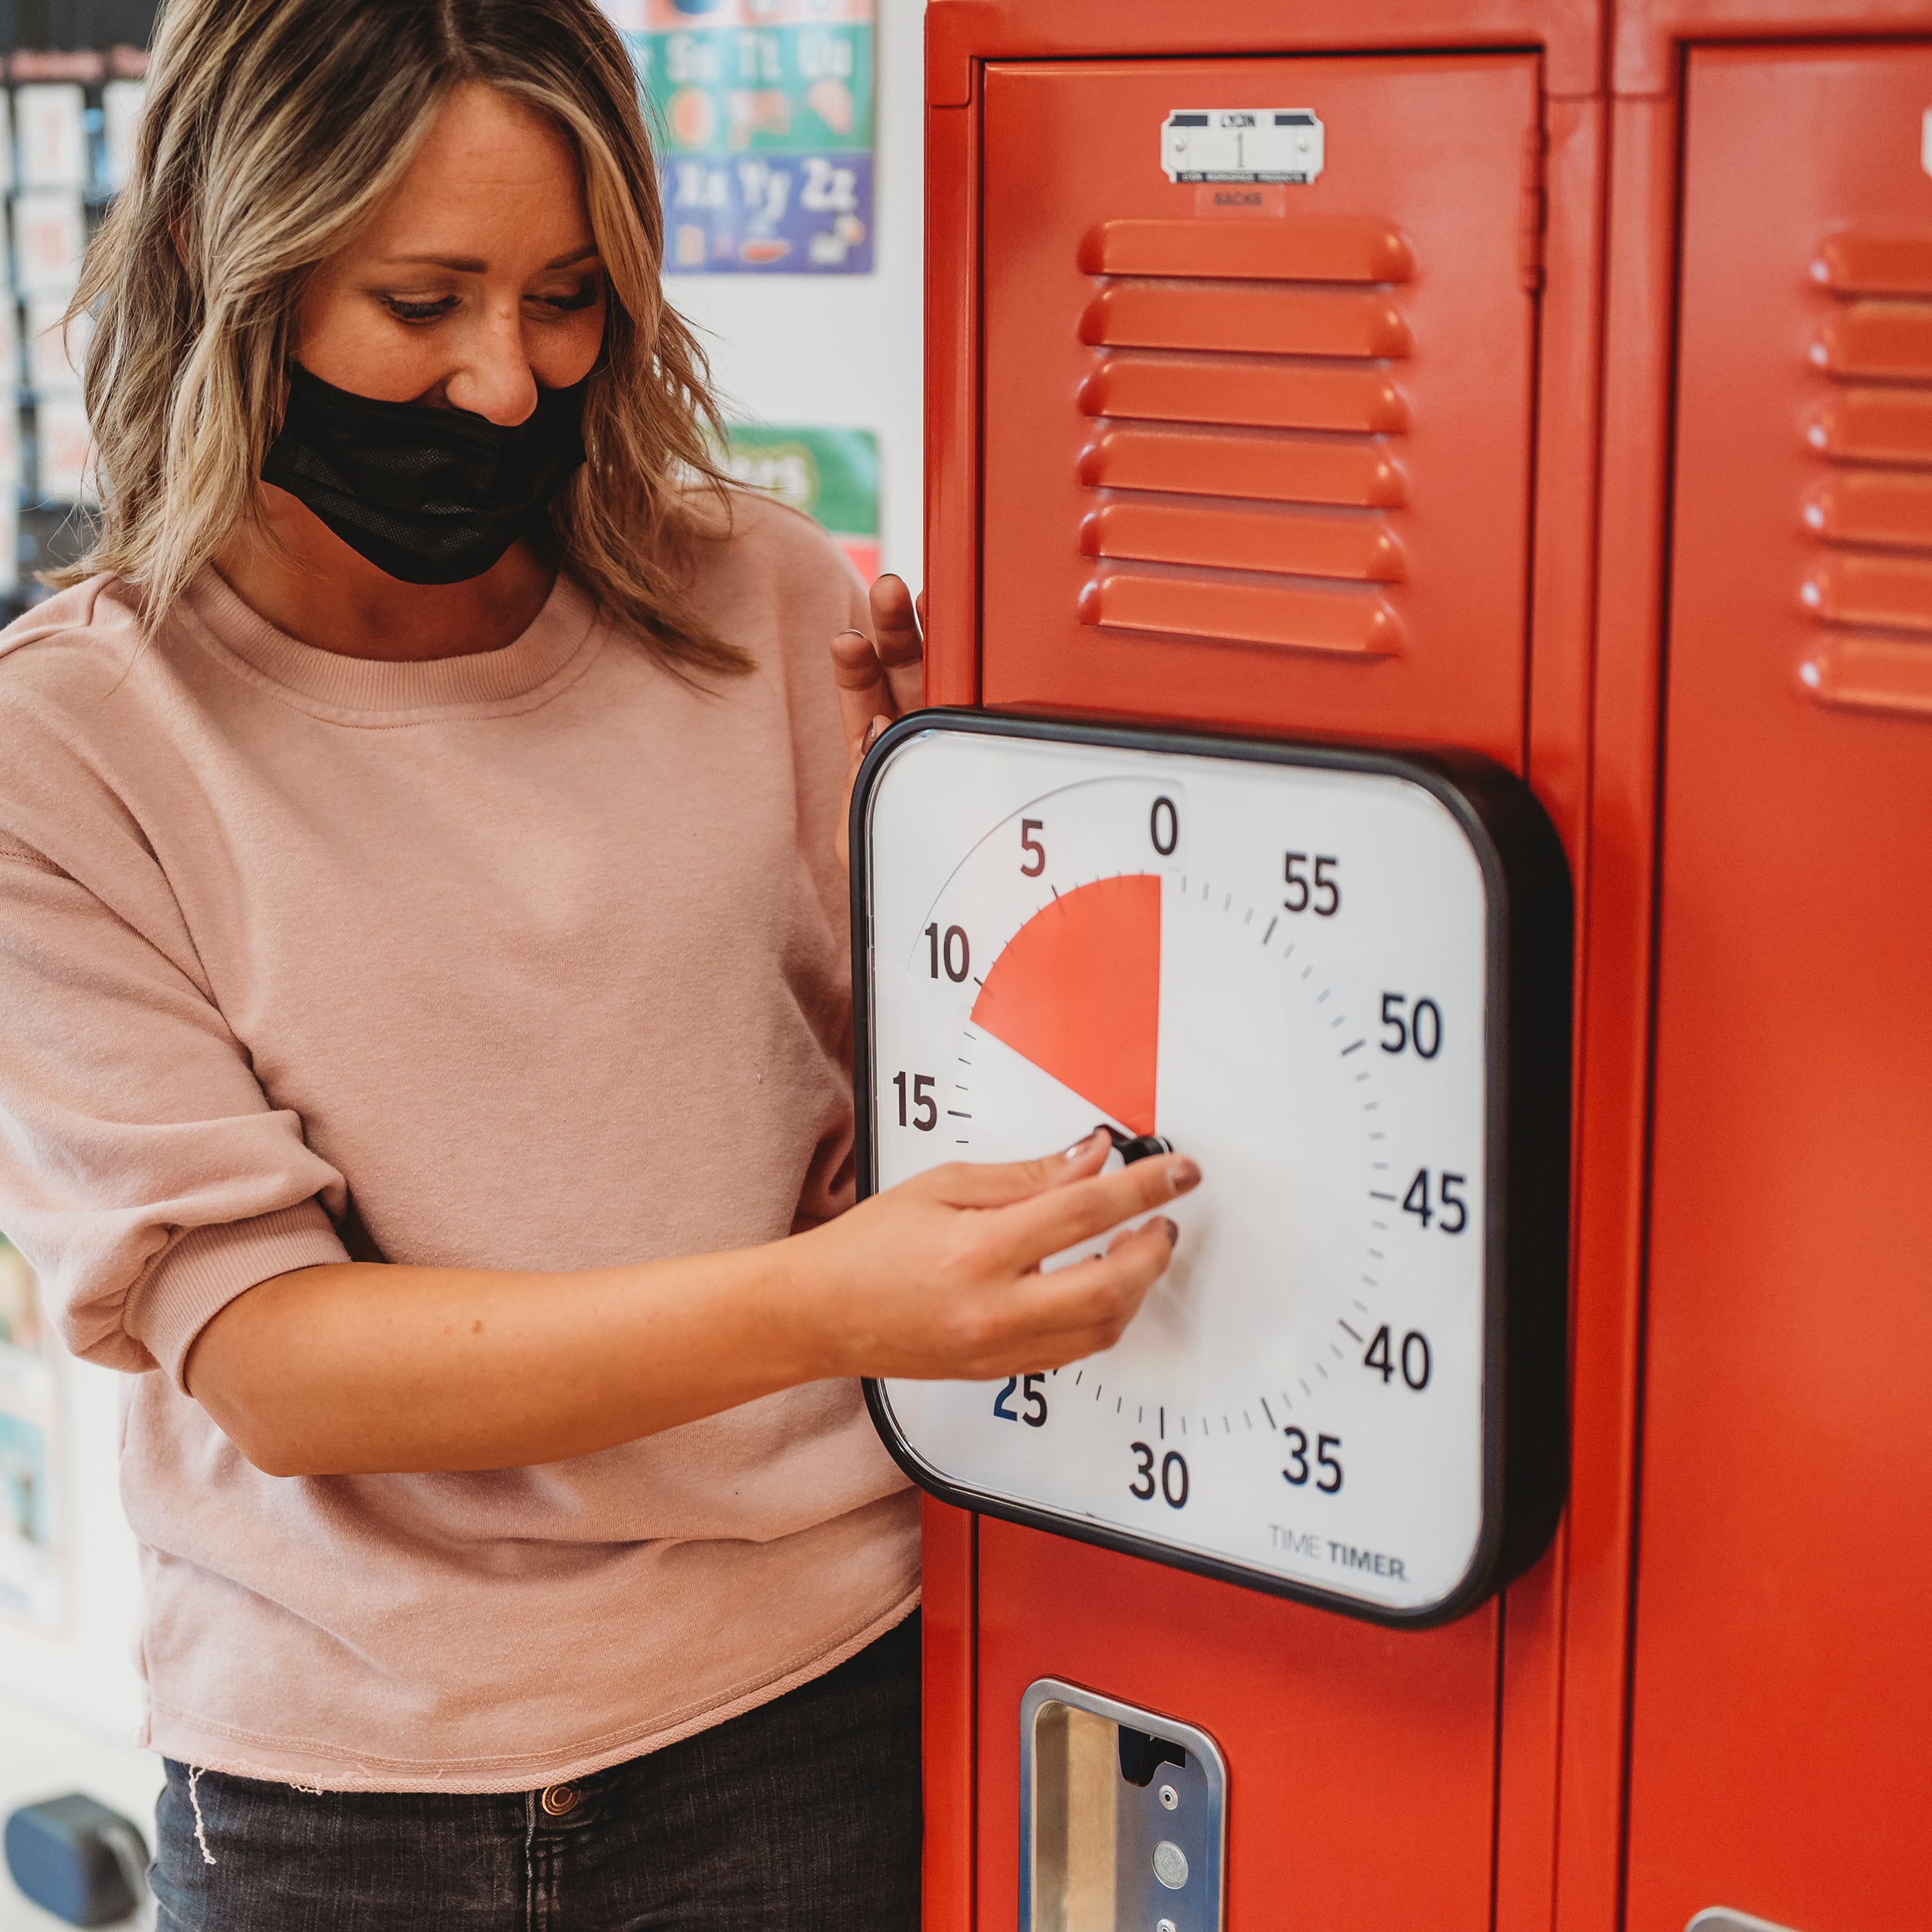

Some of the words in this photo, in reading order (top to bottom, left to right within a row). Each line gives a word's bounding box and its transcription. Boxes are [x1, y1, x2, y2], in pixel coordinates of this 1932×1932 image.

[1020, 818, 1046, 879] 5
[1150, 796, 1179, 856] 0
[1284, 852, 1341, 917] 55
[923, 921, 971, 984] 10
[1380, 992, 1442, 1060] 50
[892, 1070, 938, 1132] 15
[1401, 1168, 1468, 1235] 45
[1363, 1324, 1431, 1392] 40
[993, 1371, 1049, 1428] 25
[1128, 1440, 1189, 1510] 30
[1282, 1425, 1344, 1494] 35
[1267, 1522, 1321, 1560] TIME
